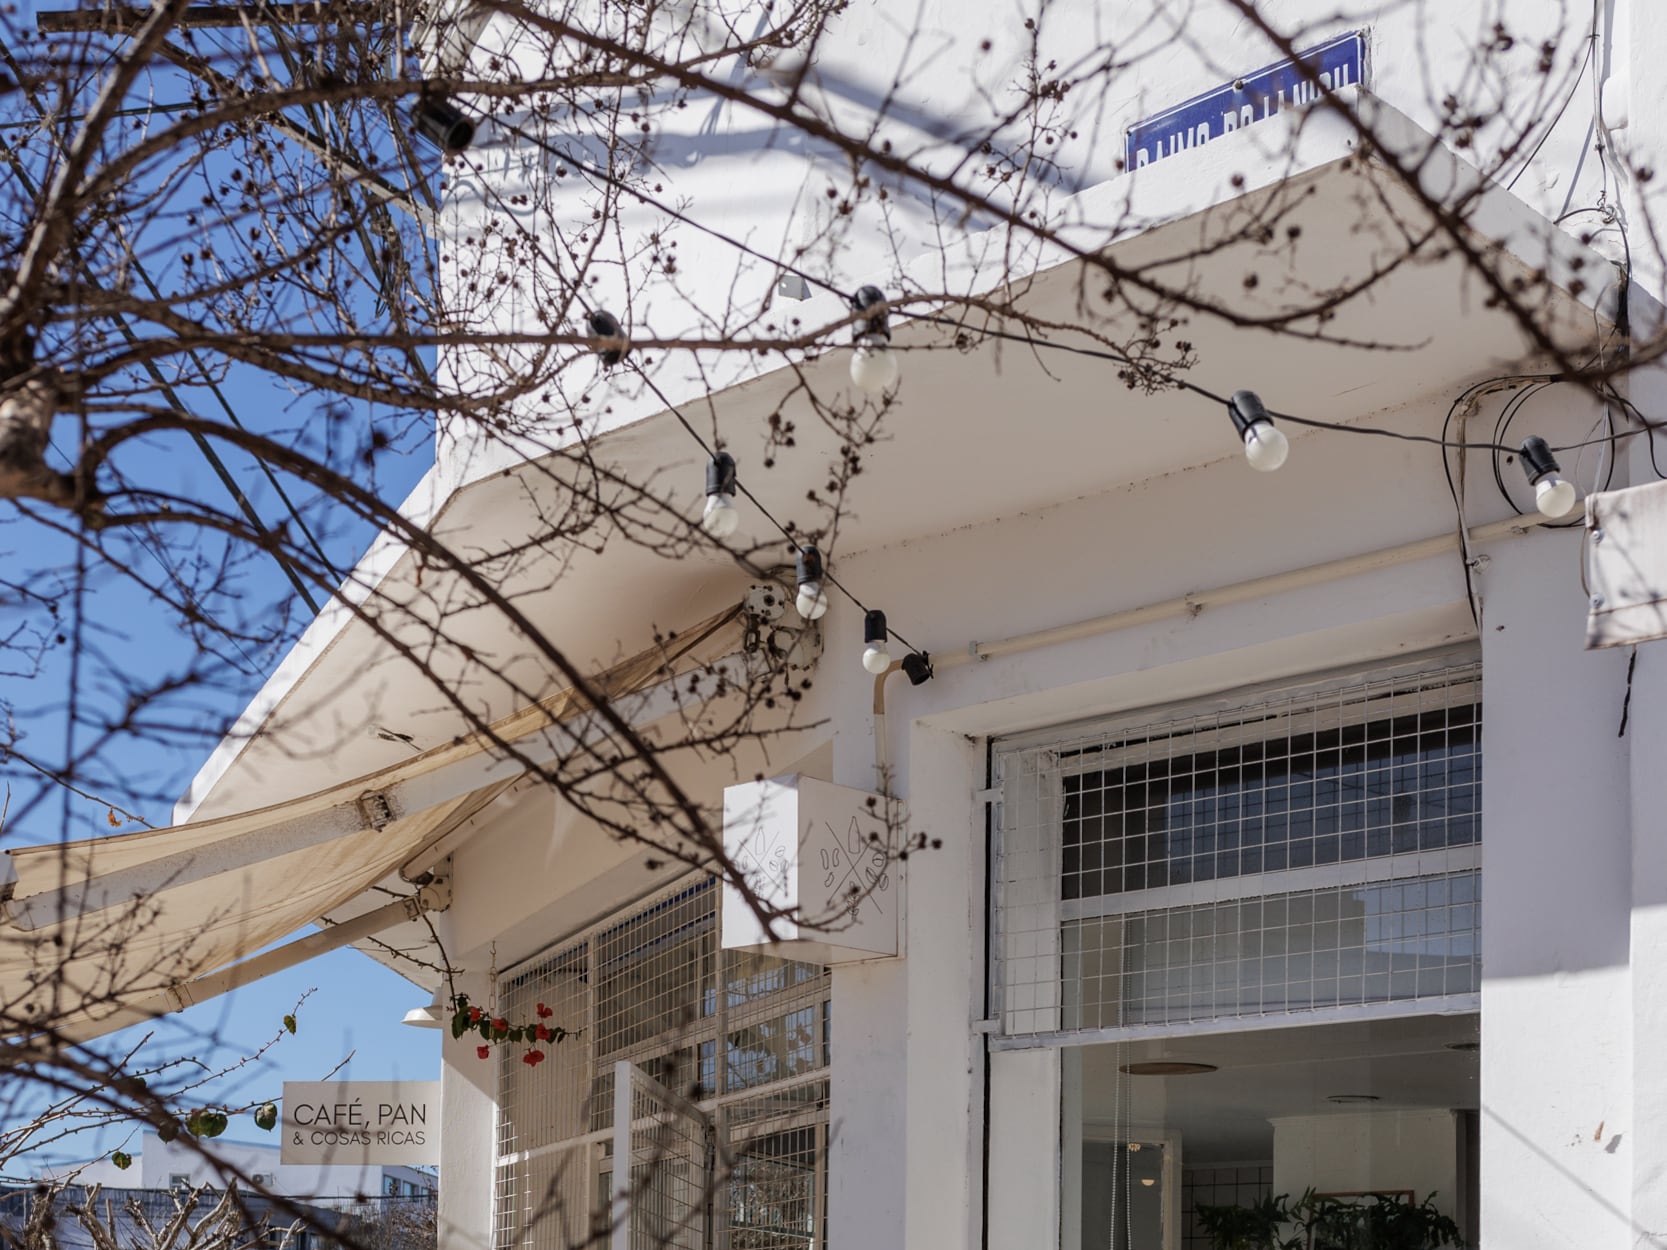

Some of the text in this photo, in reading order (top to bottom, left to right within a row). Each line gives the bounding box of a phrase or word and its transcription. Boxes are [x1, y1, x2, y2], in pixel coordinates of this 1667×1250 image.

[294, 1098, 426, 1129] CAFÉ, PAN
[293, 1131, 425, 1145] & COSAS RICAS
